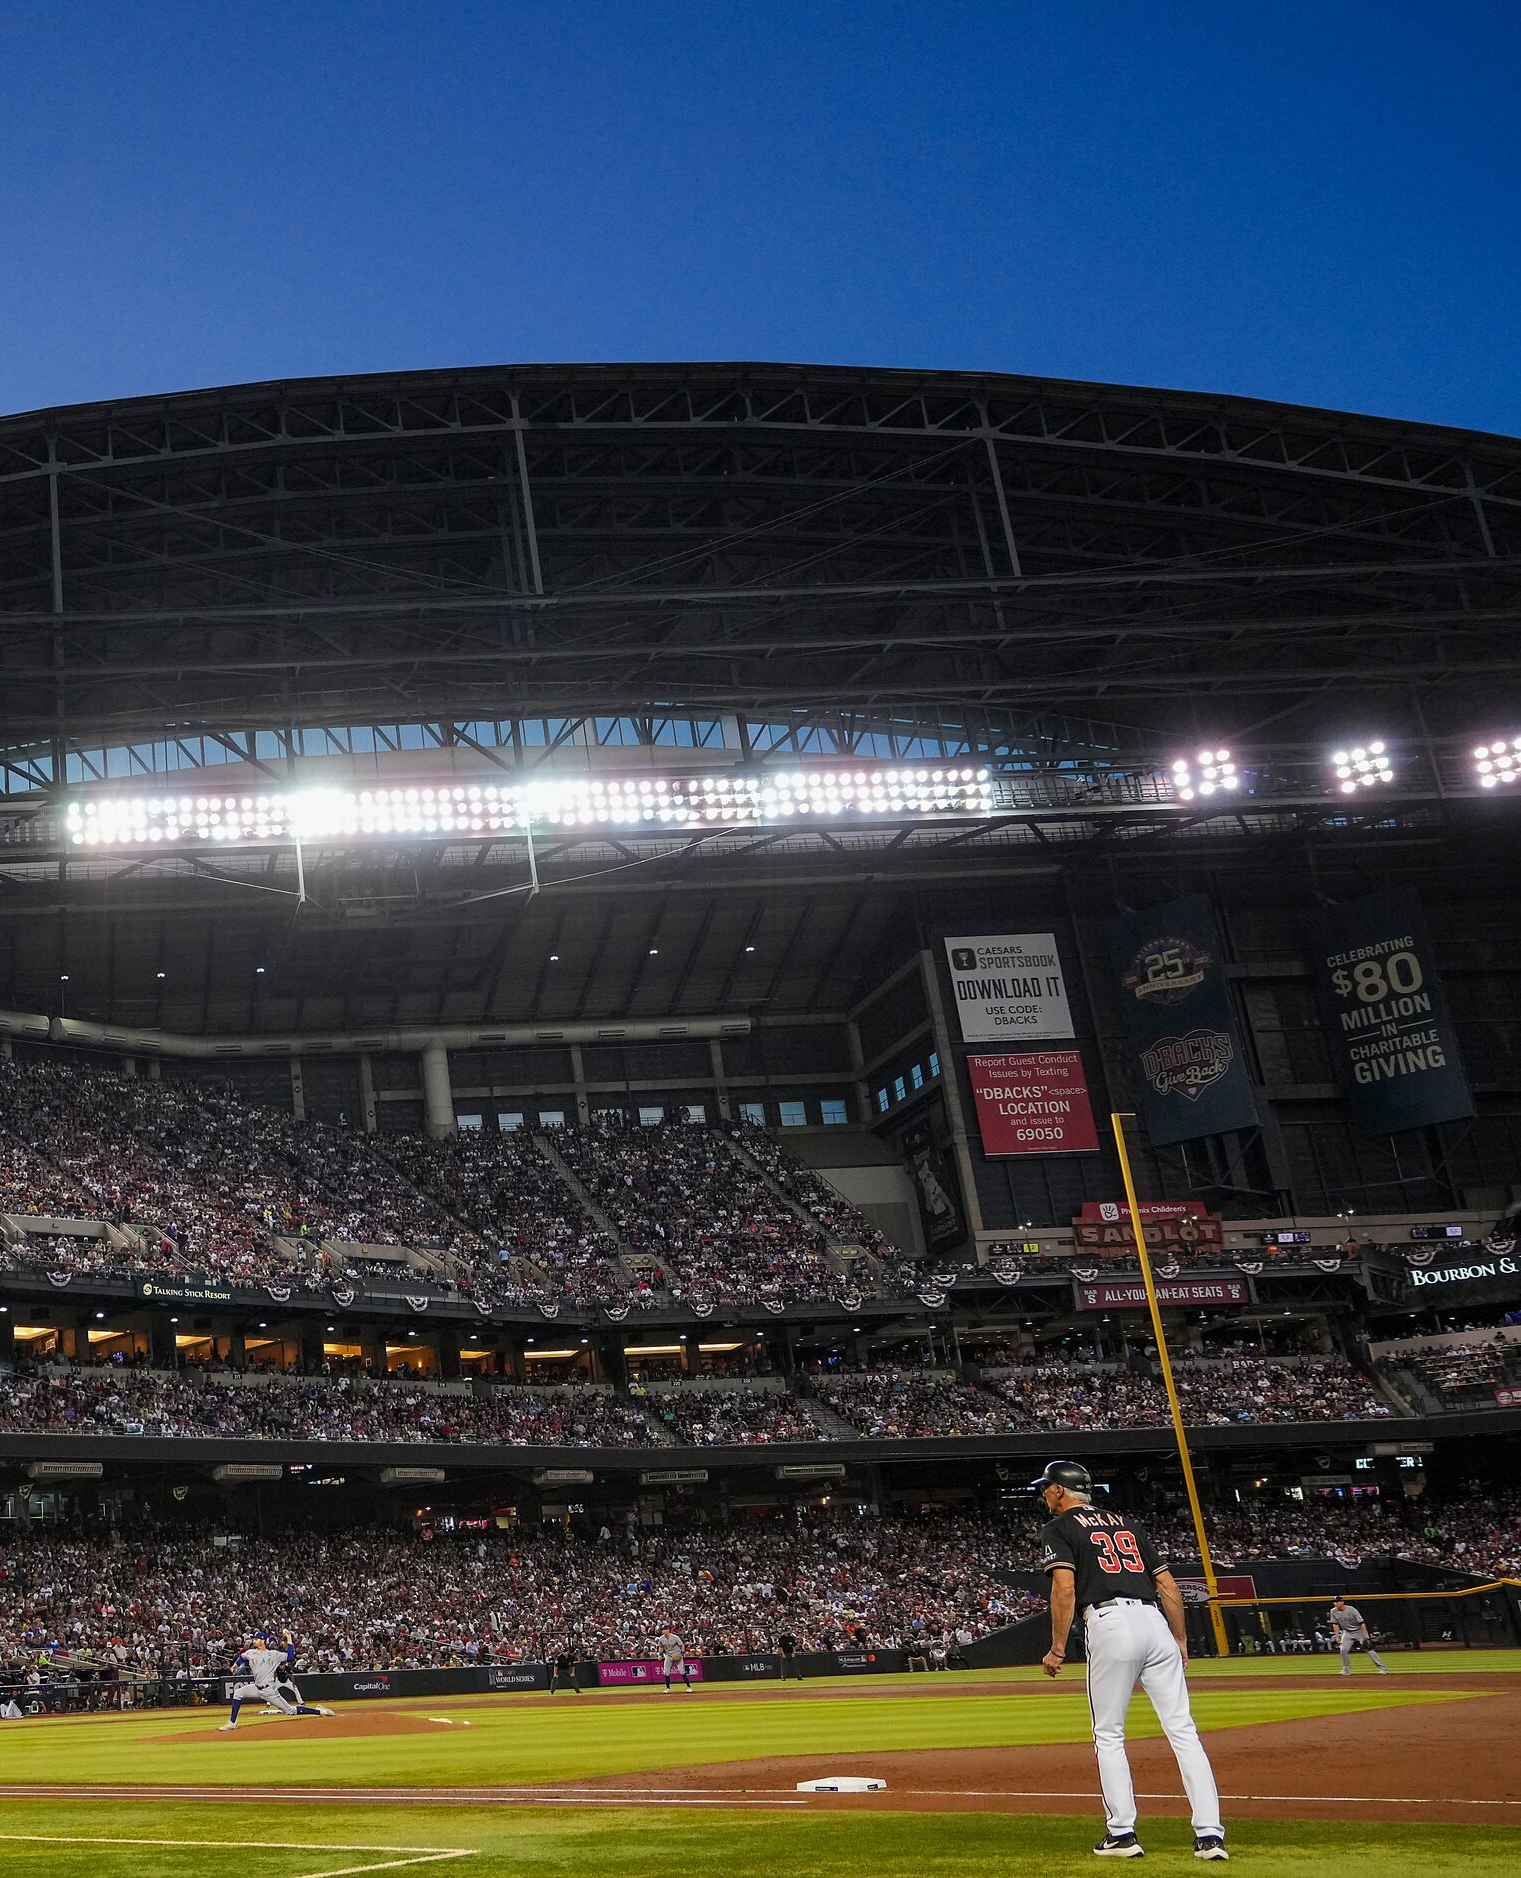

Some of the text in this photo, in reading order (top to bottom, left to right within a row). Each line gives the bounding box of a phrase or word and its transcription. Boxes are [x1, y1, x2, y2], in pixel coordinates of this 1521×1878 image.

[977, 946, 1022, 955] CAESARS
[1327, 936, 1414, 967] CELEBRATING
[979, 955, 1056, 969] SPORTSBOOK
[1145, 948, 1185, 982] 25
[1332, 952, 1423, 1002] $80
[956, 977, 1060, 1000] DOWNLOAD IT
[986, 1005, 1042, 1015] USE CODE:
[1341, 993, 1431, 1031] MILLION
[995, 1016, 1037, 1026] DBACKS
[1381, 1022, 1398, 1037] IN
[1350, 1029, 1439, 1060] CHARITABLE
[975, 1054, 1078, 1068] Report Guest Conduct
[1354, 1045, 1446, 1084] GIVING
[988, 1067, 1069, 1078] Issues by Texting
[1156, 1059, 1226, 1091] Give Back
[1048, 1086, 1087, 1096] <space>
[999, 1100, 1070, 1115] LOCATION
[1010, 1116, 1064, 1126] and issue to
[1016, 1127, 1063, 1140] 69050
[1121, 1207, 1150, 1215] Phnix
[1410, 1257, 1518, 1287] BOURBON &
[153, 1286, 231, 1299] TALKING STICK RESORT
[1104, 1286, 1224, 1301] ALL-YOU-AN-EAT SEATS
[1073, 1513, 1125, 1528] McKAY
[1090, 1531, 1145, 1574] 39
[1182, 1591, 1198, 1601] ord
[750, 1662, 765, 1672] MLB
